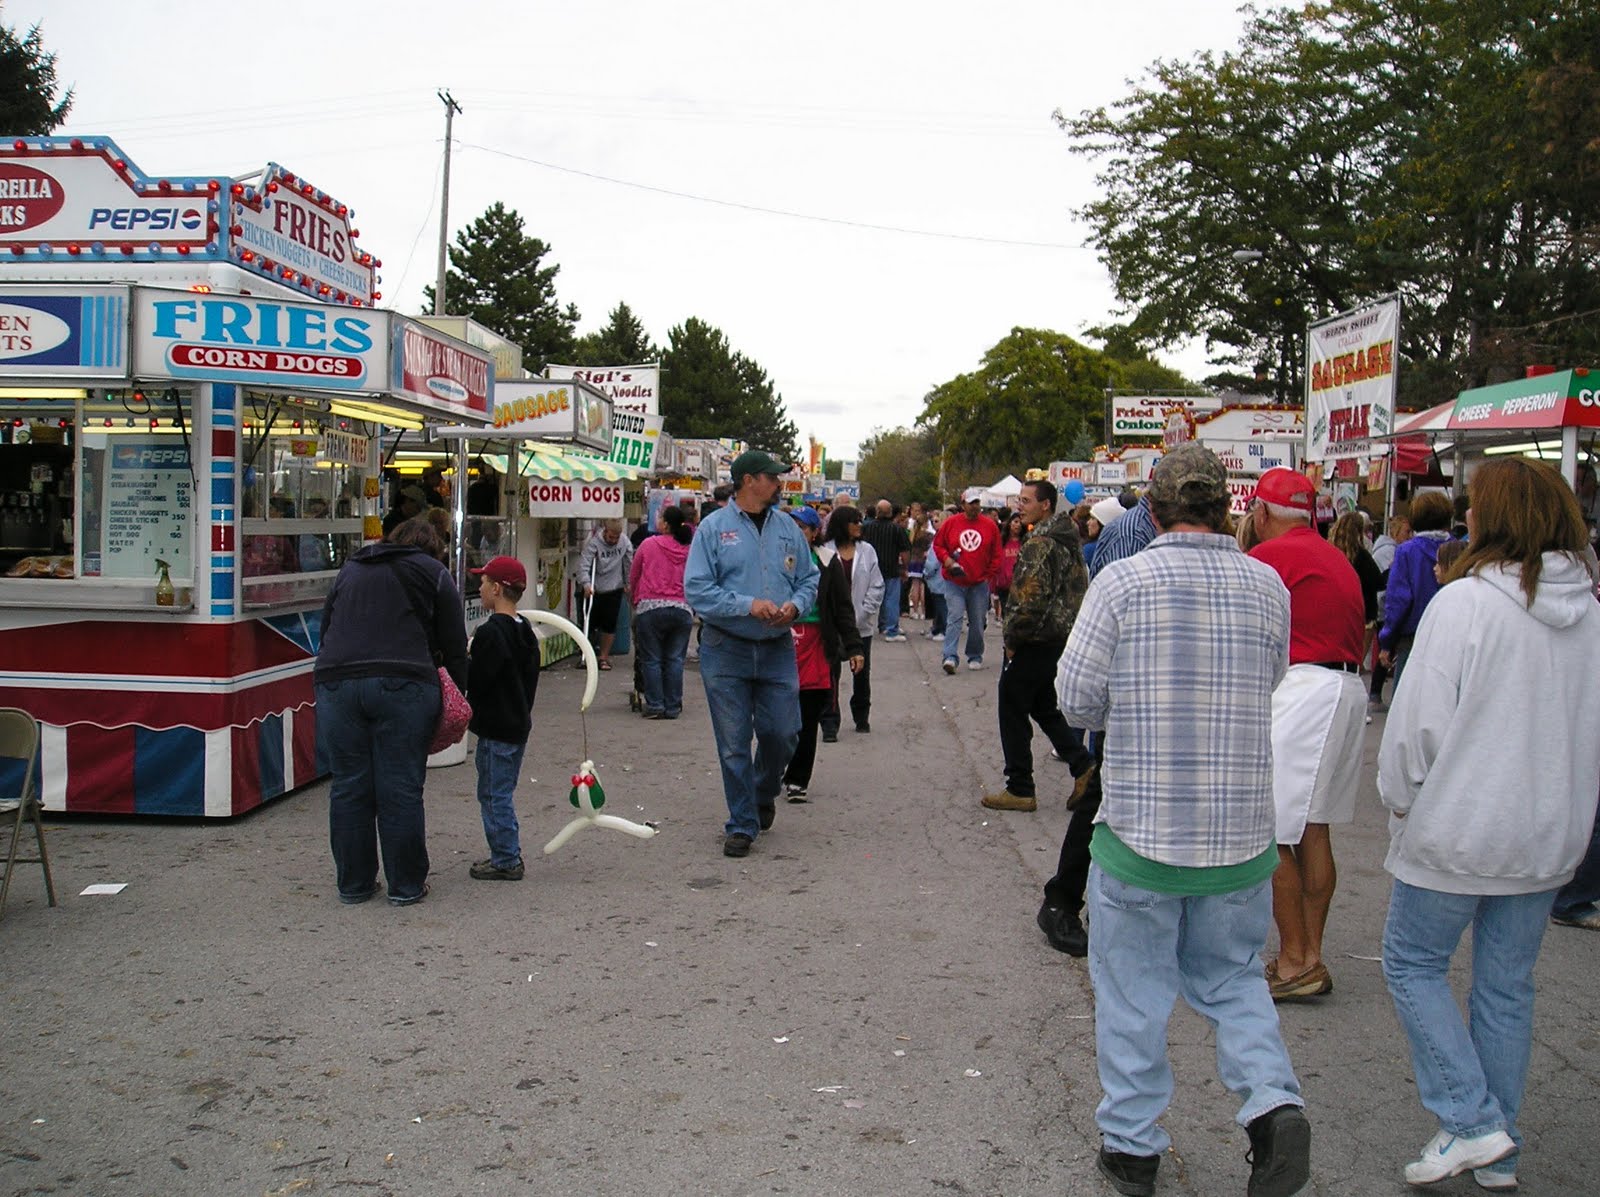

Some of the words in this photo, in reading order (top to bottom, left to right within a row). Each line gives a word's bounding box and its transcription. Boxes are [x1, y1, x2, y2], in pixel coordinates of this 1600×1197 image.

[0, 205, 26, 225] KS
[88, 208, 179, 230] PEPSI
[274, 200, 345, 263] FRIES
[276, 234, 311, 268] NUGGETS
[319, 257, 344, 283] CHEESE
[345, 267, 367, 294] STICKS
[152, 300, 373, 354] FRIES
[187, 348, 266, 368] CORN
[276, 354, 348, 373] DOGS
[1312, 340, 1393, 391] SAUSAGE
[610, 386, 652, 398] Noodles
[494, 388, 570, 429] SAUSAGE
[1116, 408, 1154, 417] Fried
[1140, 399, 1194, 407] Carolyn's
[1459, 403, 1493, 422] CHEESE
[1502, 391, 1558, 415] PEPPERONI
[140, 450, 188, 464] PEPSI
[1249, 445, 1264, 456] COLD
[1260, 458, 1282, 469] DRINKS
[530, 485, 572, 502] CORN
[581, 486, 621, 503] DOGS
